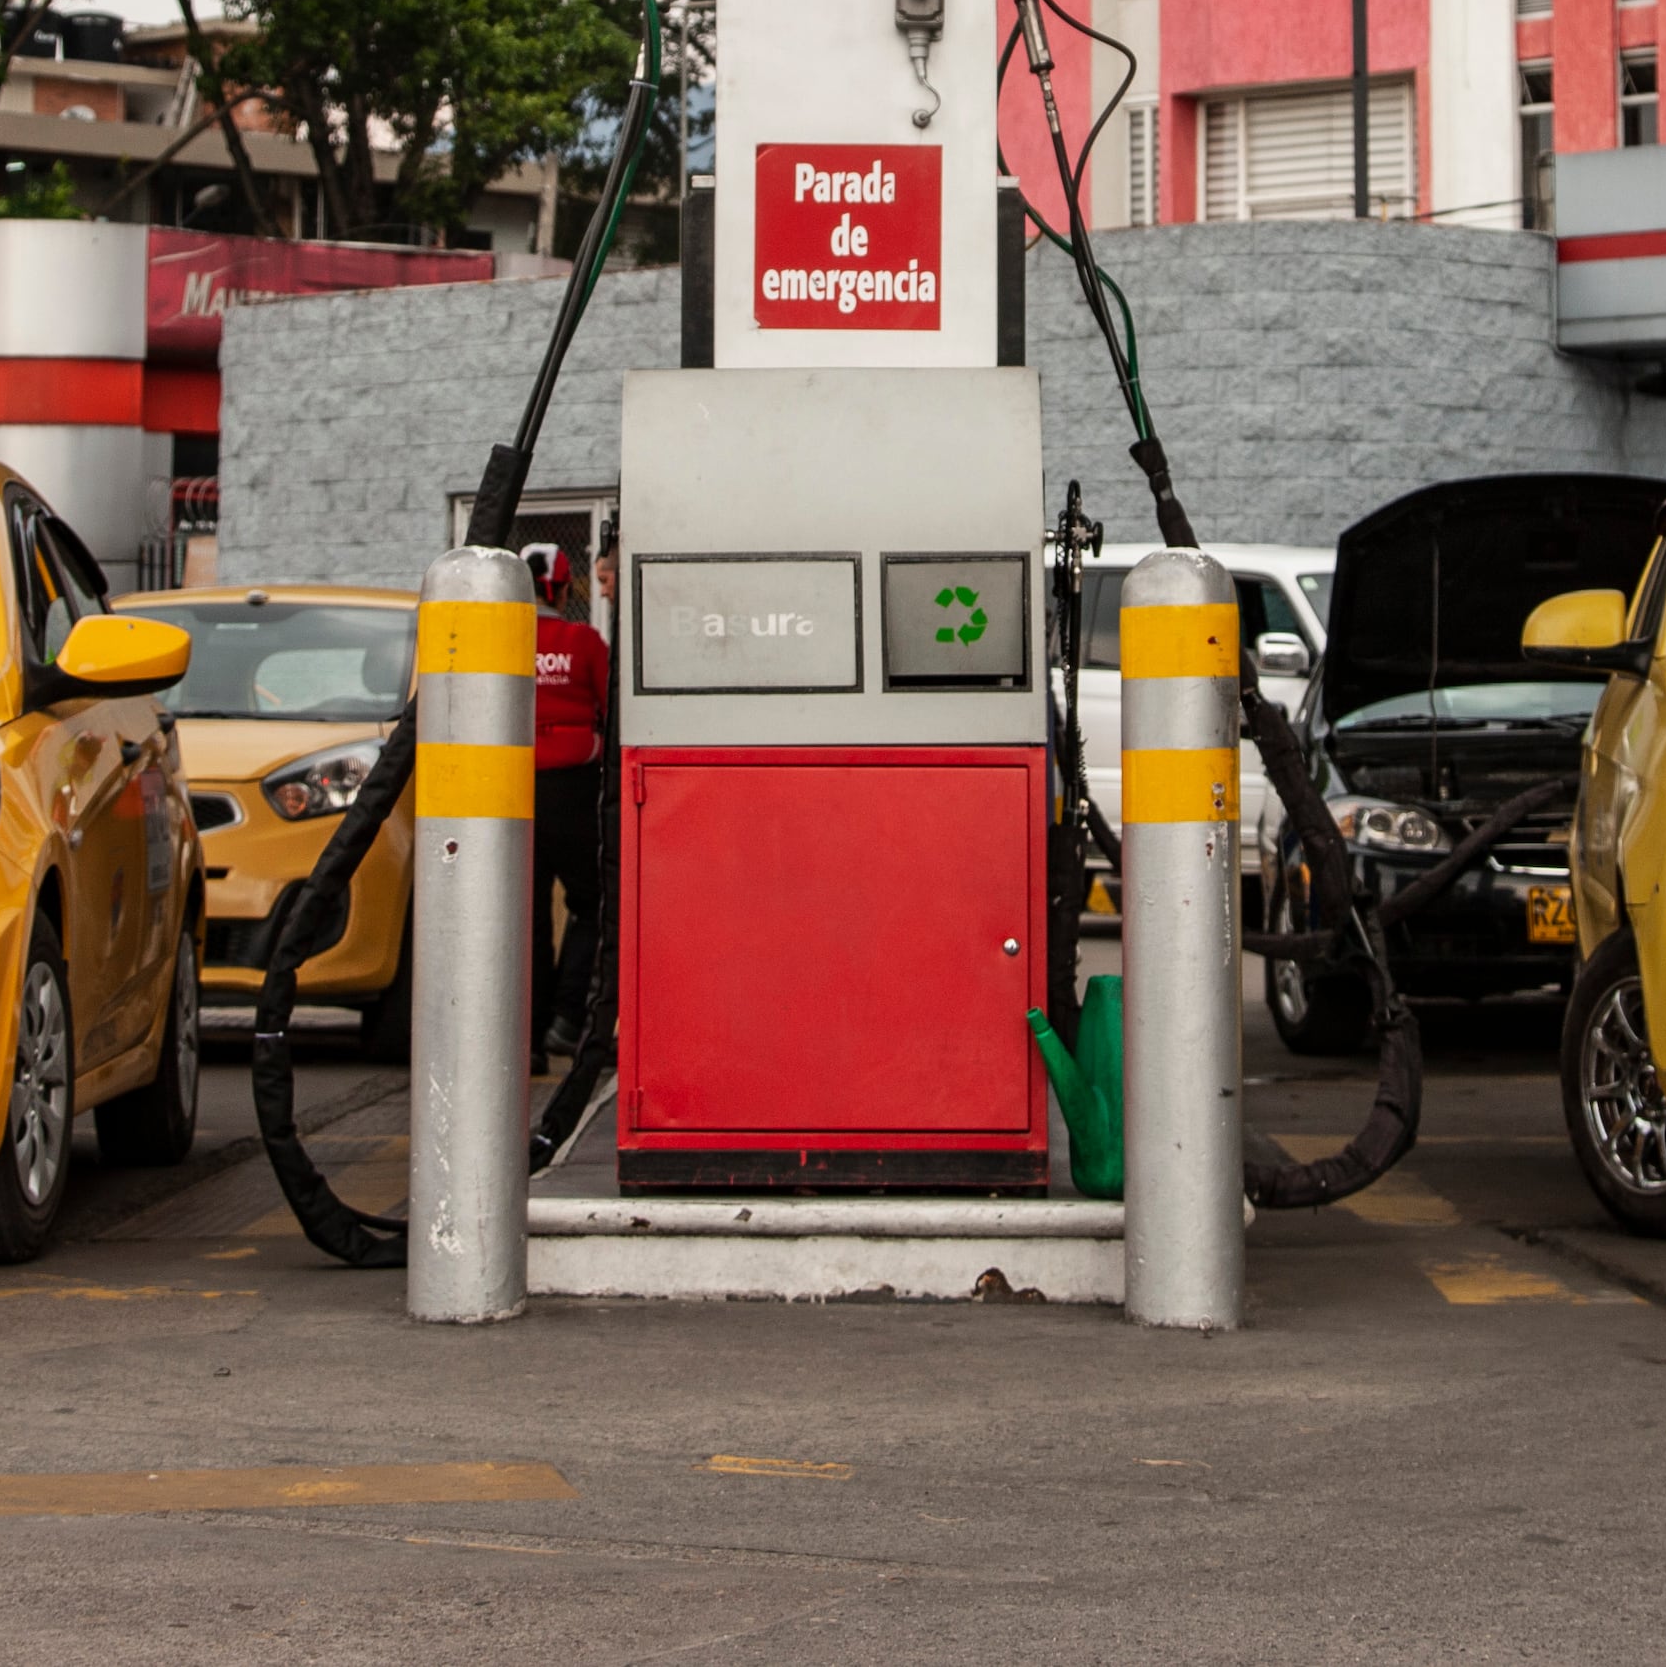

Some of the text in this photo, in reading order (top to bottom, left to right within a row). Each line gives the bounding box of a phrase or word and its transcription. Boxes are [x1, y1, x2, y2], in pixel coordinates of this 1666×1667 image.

[794, 159, 895, 204] Parada
[830, 212, 869, 257] de
[762, 258, 937, 314] emergencia
